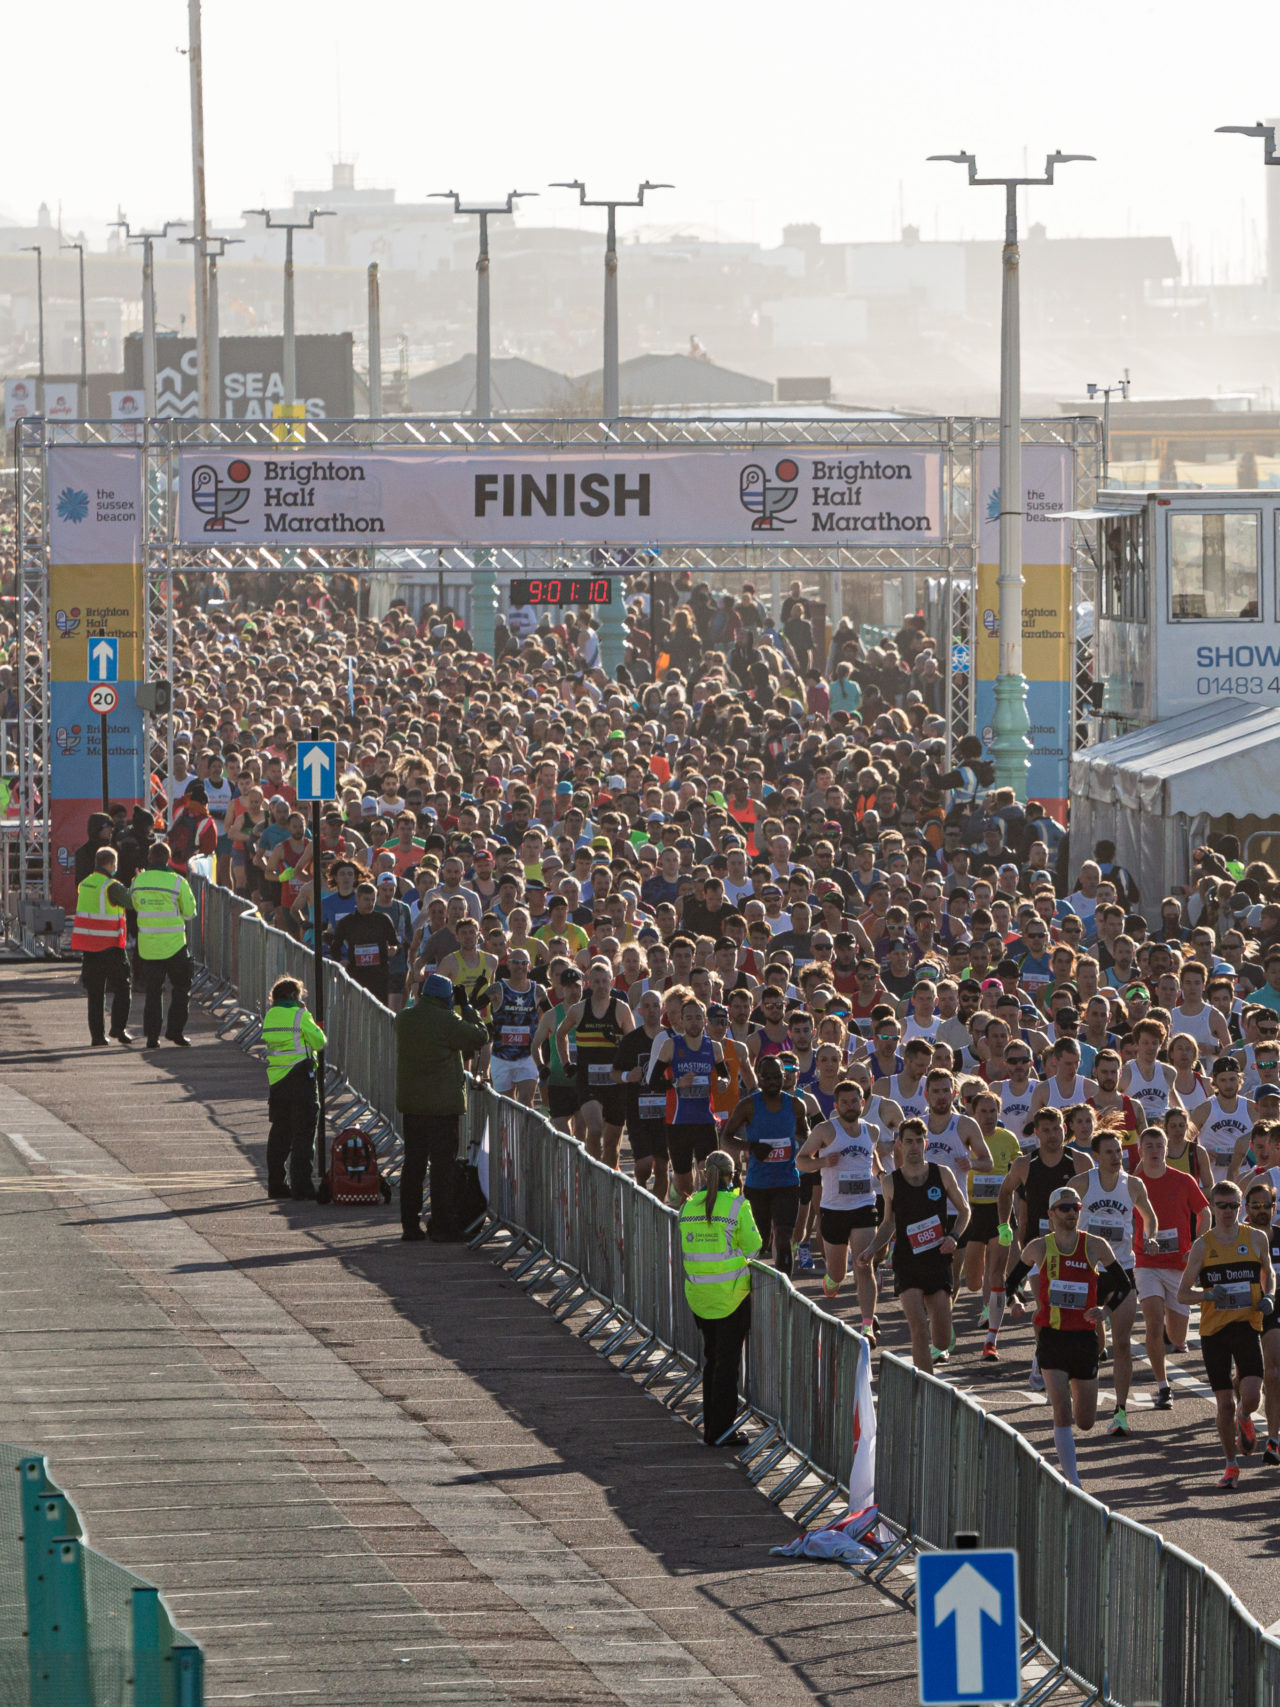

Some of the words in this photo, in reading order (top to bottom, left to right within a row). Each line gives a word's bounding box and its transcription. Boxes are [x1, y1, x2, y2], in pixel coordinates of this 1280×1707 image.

[224, 372, 285, 398] SEA
[264, 461, 365, 485] Brighton
[812, 460, 912, 484] Brighton
[96, 489, 115, 500] the
[264, 487, 315, 507] Half
[474, 473, 650, 517] FINISH
[812, 487, 862, 506] Half
[1027, 489, 1045, 500] the
[96, 501, 134, 510] sussex
[1026, 502, 1064, 511] sussex
[96, 512, 136, 522] beacon
[264, 513, 385, 532] Marathon
[811, 512, 932, 532] Marathon
[86, 608, 129, 618] Brighton
[1021, 608, 1057, 618] righton
[86, 619, 108, 627] Half
[1021, 619, 1036, 628] alf
[1196, 676, 1264, 695] 01483
[93, 693, 115, 705] 20
[87, 725, 130, 736] Brihton
[87, 747, 139, 755] Maathon
[360, 955, 375, 963] 547
[1002, 1104, 1029, 1116] PHOENI
[1210, 1115, 1248, 1134] PHOENIX
[839, 1145, 870, 1157] PHOENIX
[1086, 1199, 1128, 1214] PHOENIX
[917, 1229, 936, 1243] 685
[1064, 1260, 1088, 1269] OLLIE
[1062, 1293, 1075, 1305] 13
